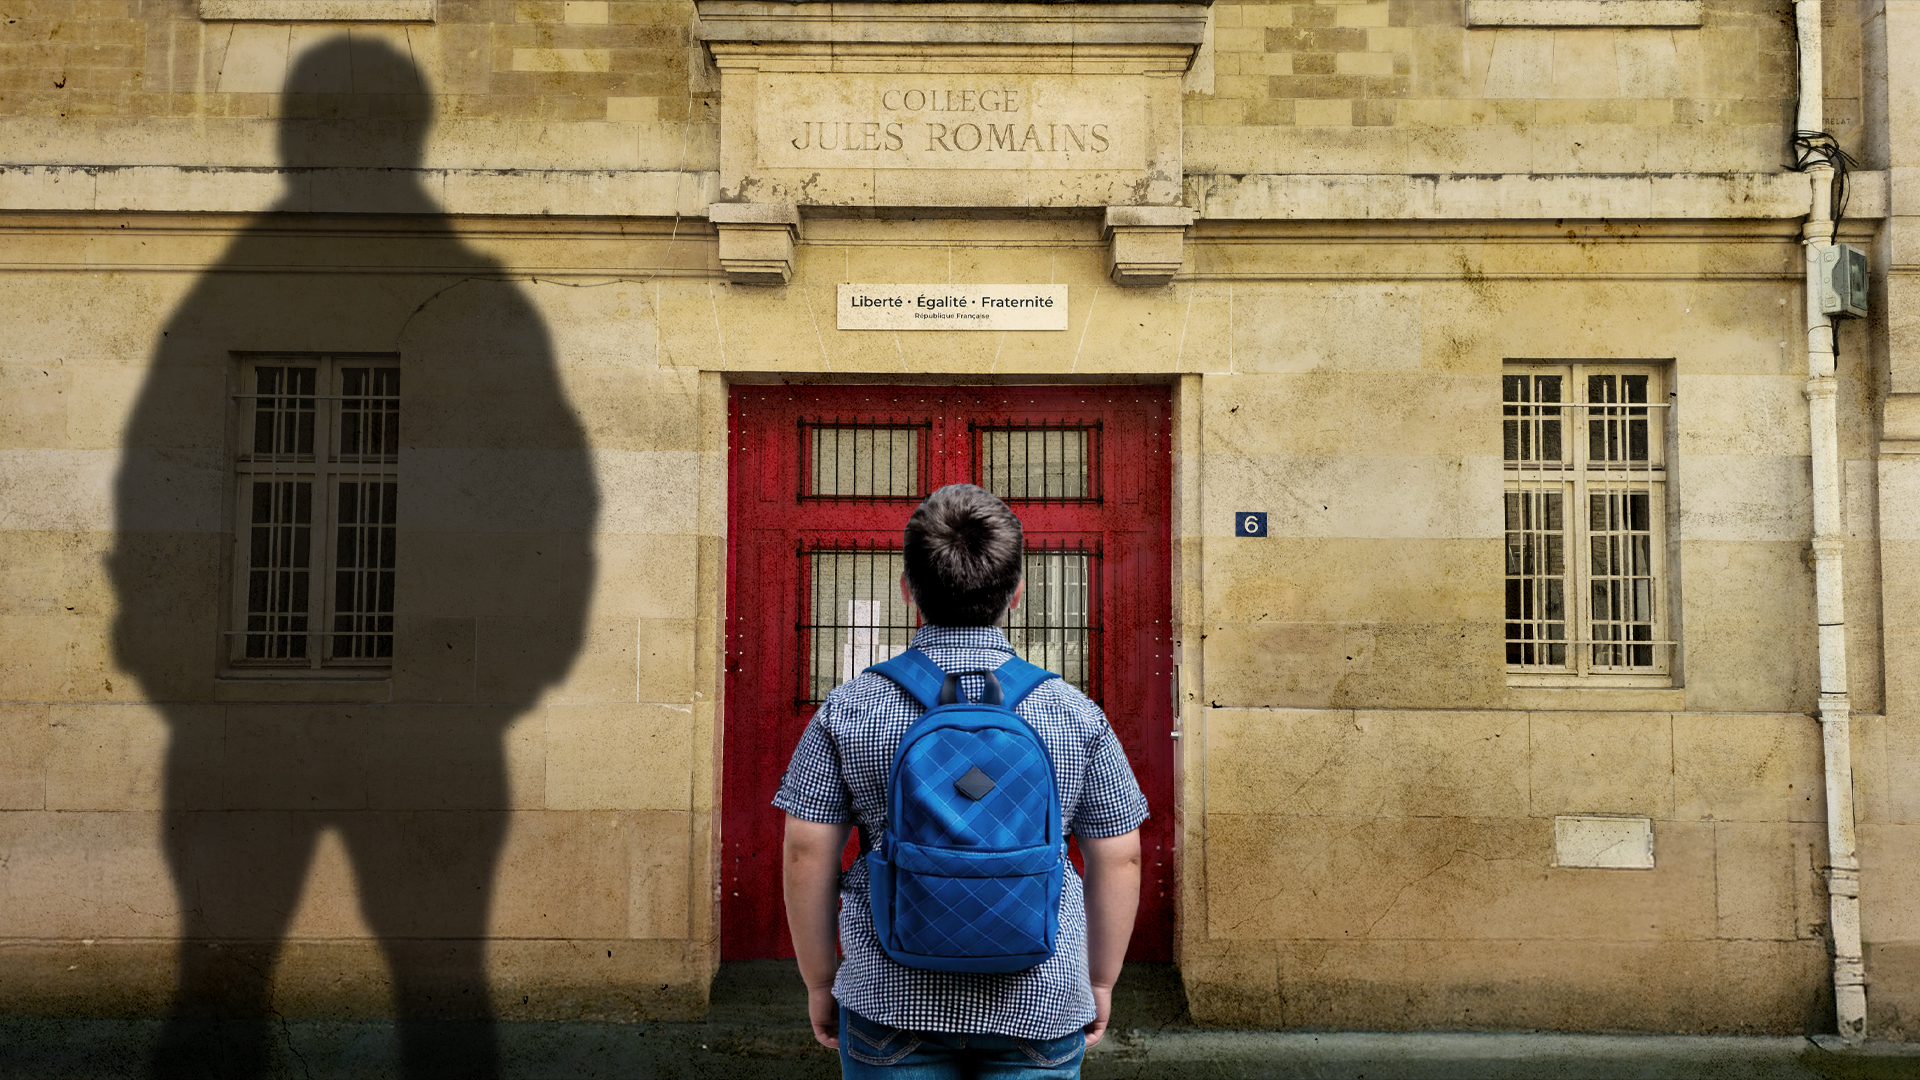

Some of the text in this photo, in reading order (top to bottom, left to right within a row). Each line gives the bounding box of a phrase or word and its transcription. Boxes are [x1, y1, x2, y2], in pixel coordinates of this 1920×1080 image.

[882, 89, 1020, 113] COLLEGE
[791, 121, 1110, 153] JULES ROMAINS
[851, 294, 1054, 310] Liberté Égalité Fraternité
[914, 312, 990, 320] République Française
[1244, 515, 1259, 534] 6
